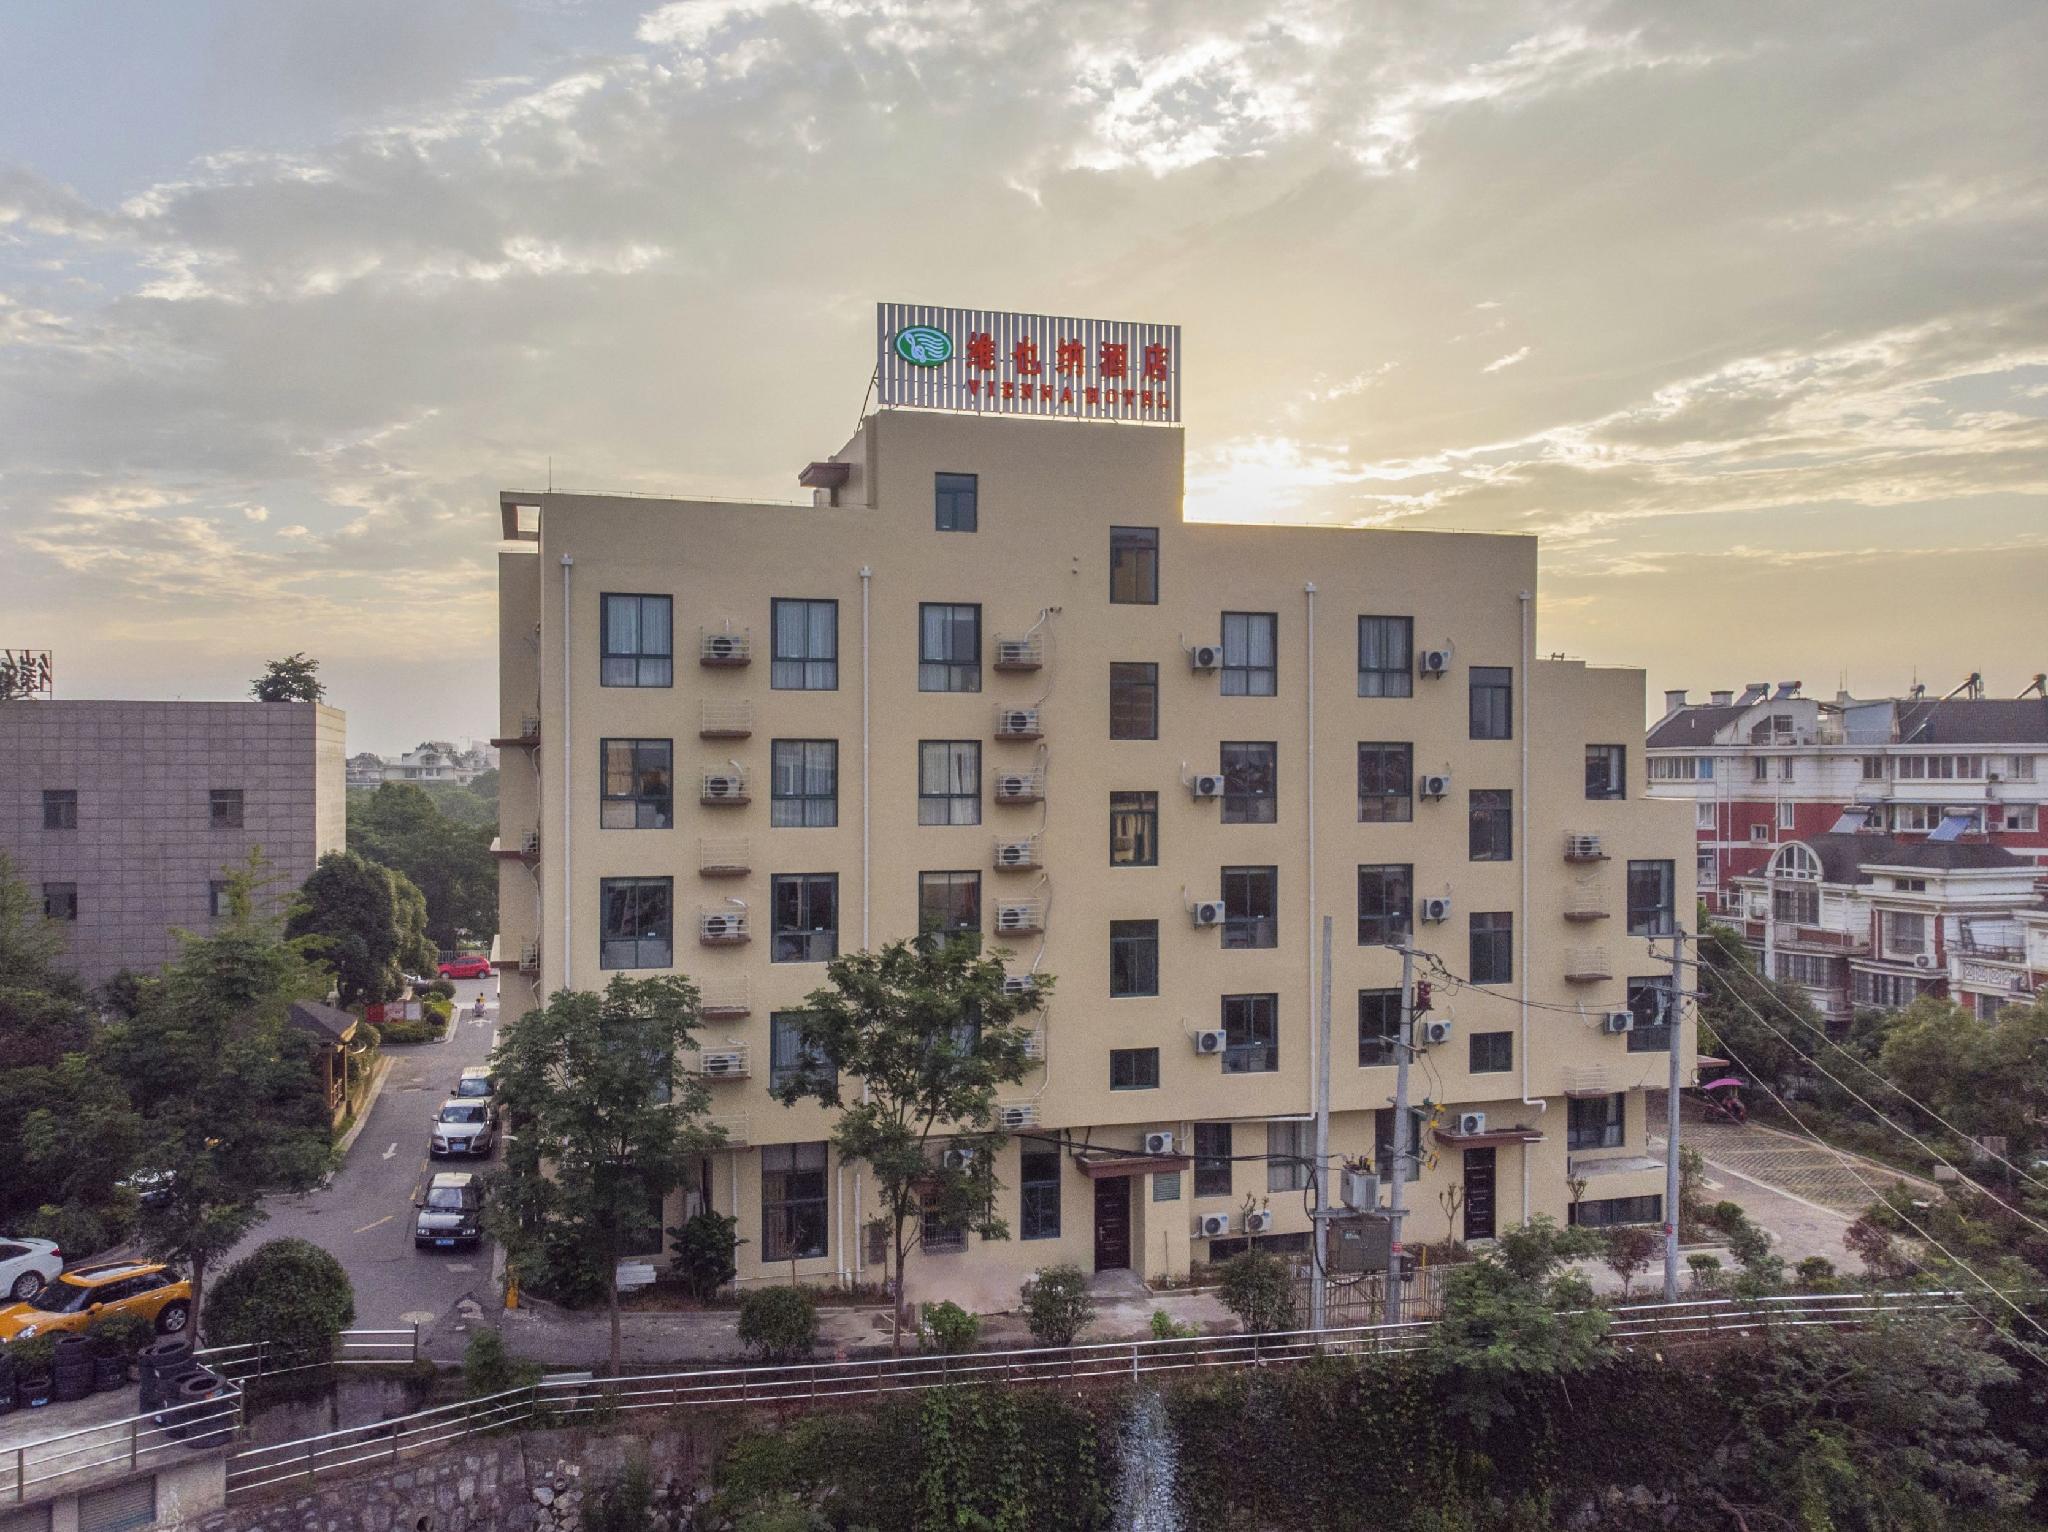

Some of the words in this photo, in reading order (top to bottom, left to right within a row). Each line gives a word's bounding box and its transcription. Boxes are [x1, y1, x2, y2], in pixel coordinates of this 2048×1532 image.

[967, 332, 1169, 382] 维也纳酒店
[968, 379, 1073, 403] VIENNA
[1085, 386, 1169, 409] HOTEL
